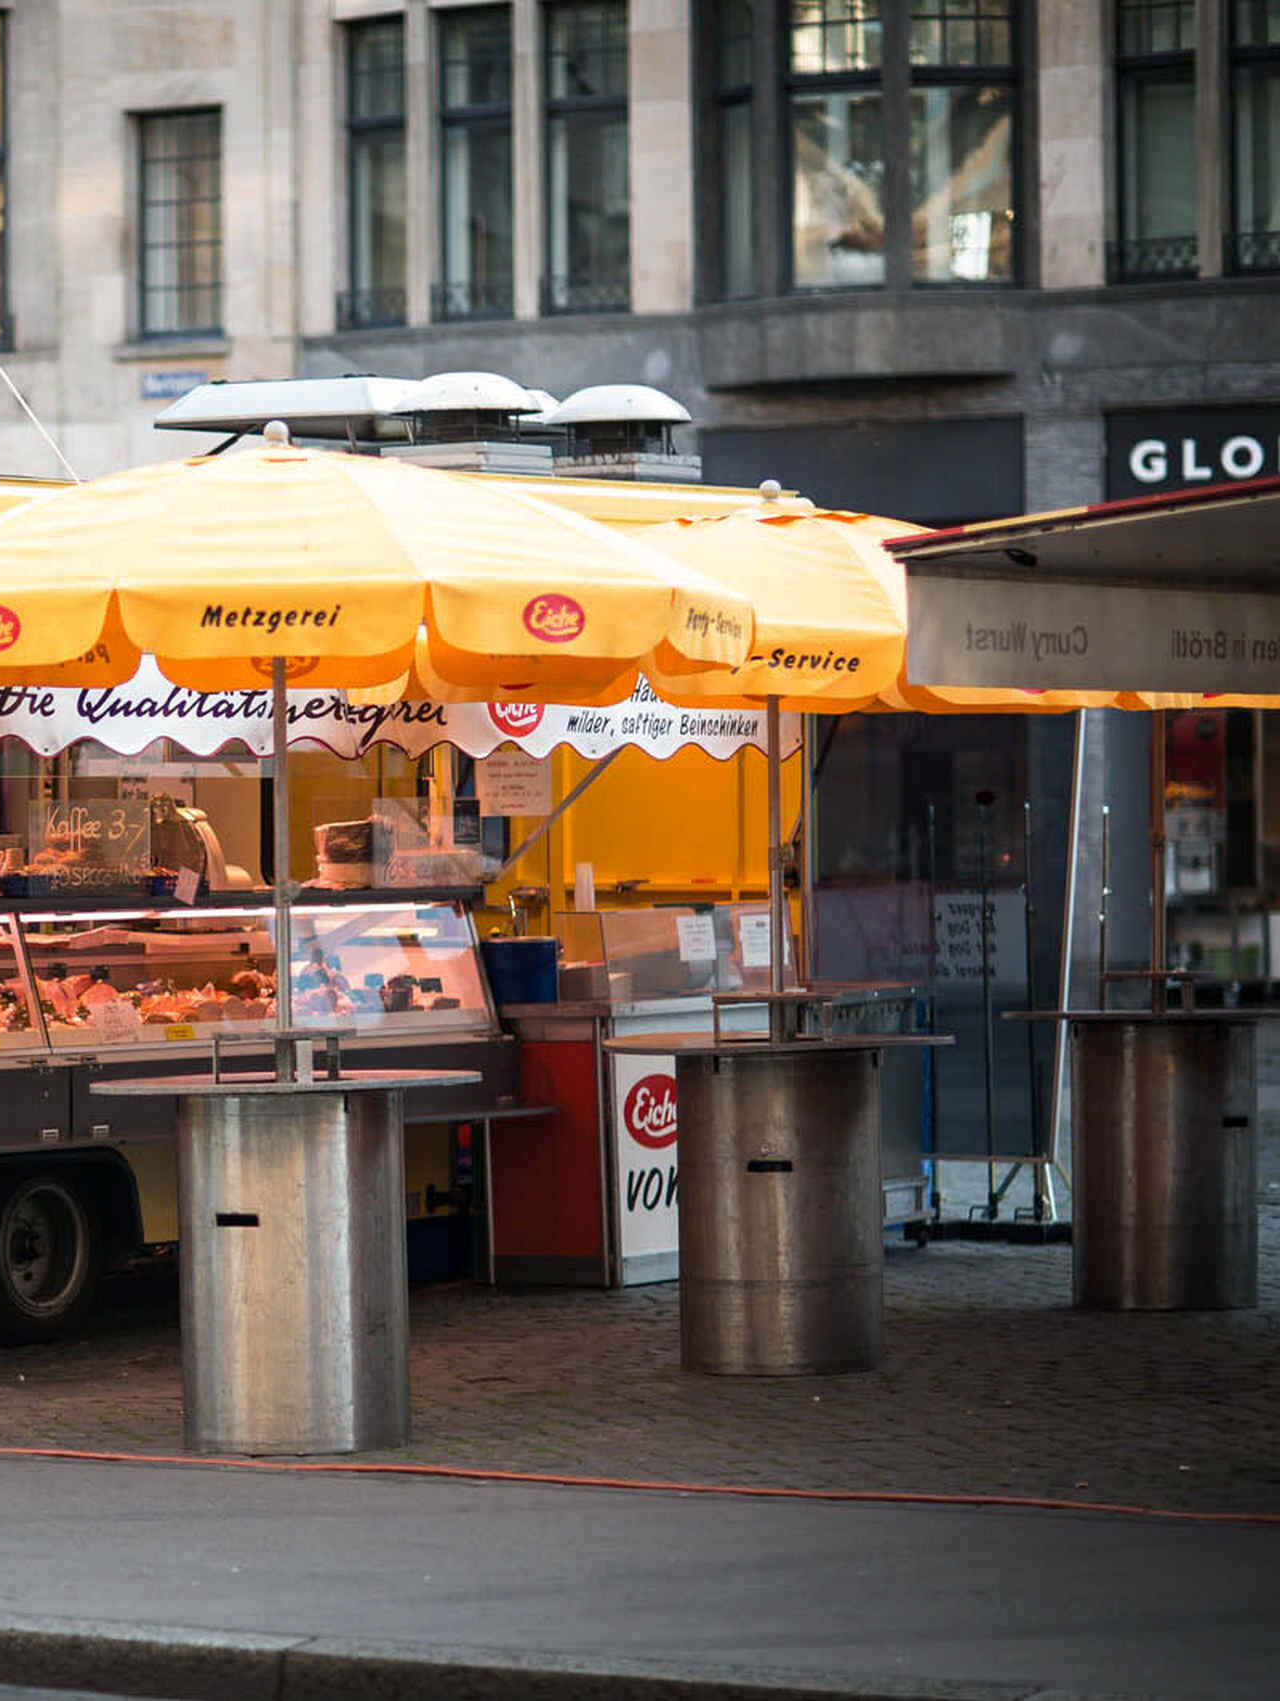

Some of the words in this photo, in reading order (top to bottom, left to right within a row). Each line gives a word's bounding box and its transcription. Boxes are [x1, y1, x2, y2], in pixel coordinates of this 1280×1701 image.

[1130, 436, 1280, 482] GLO
[201, 605, 341, 633] Metzgerei
[529, 599, 579, 636] Eiche
[622, 712, 674, 739] saftiger
[680, 713, 758, 736] Beinschinken
[46, 805, 102, 853] Kaffee
[631, 1086, 677, 1137] Eich
